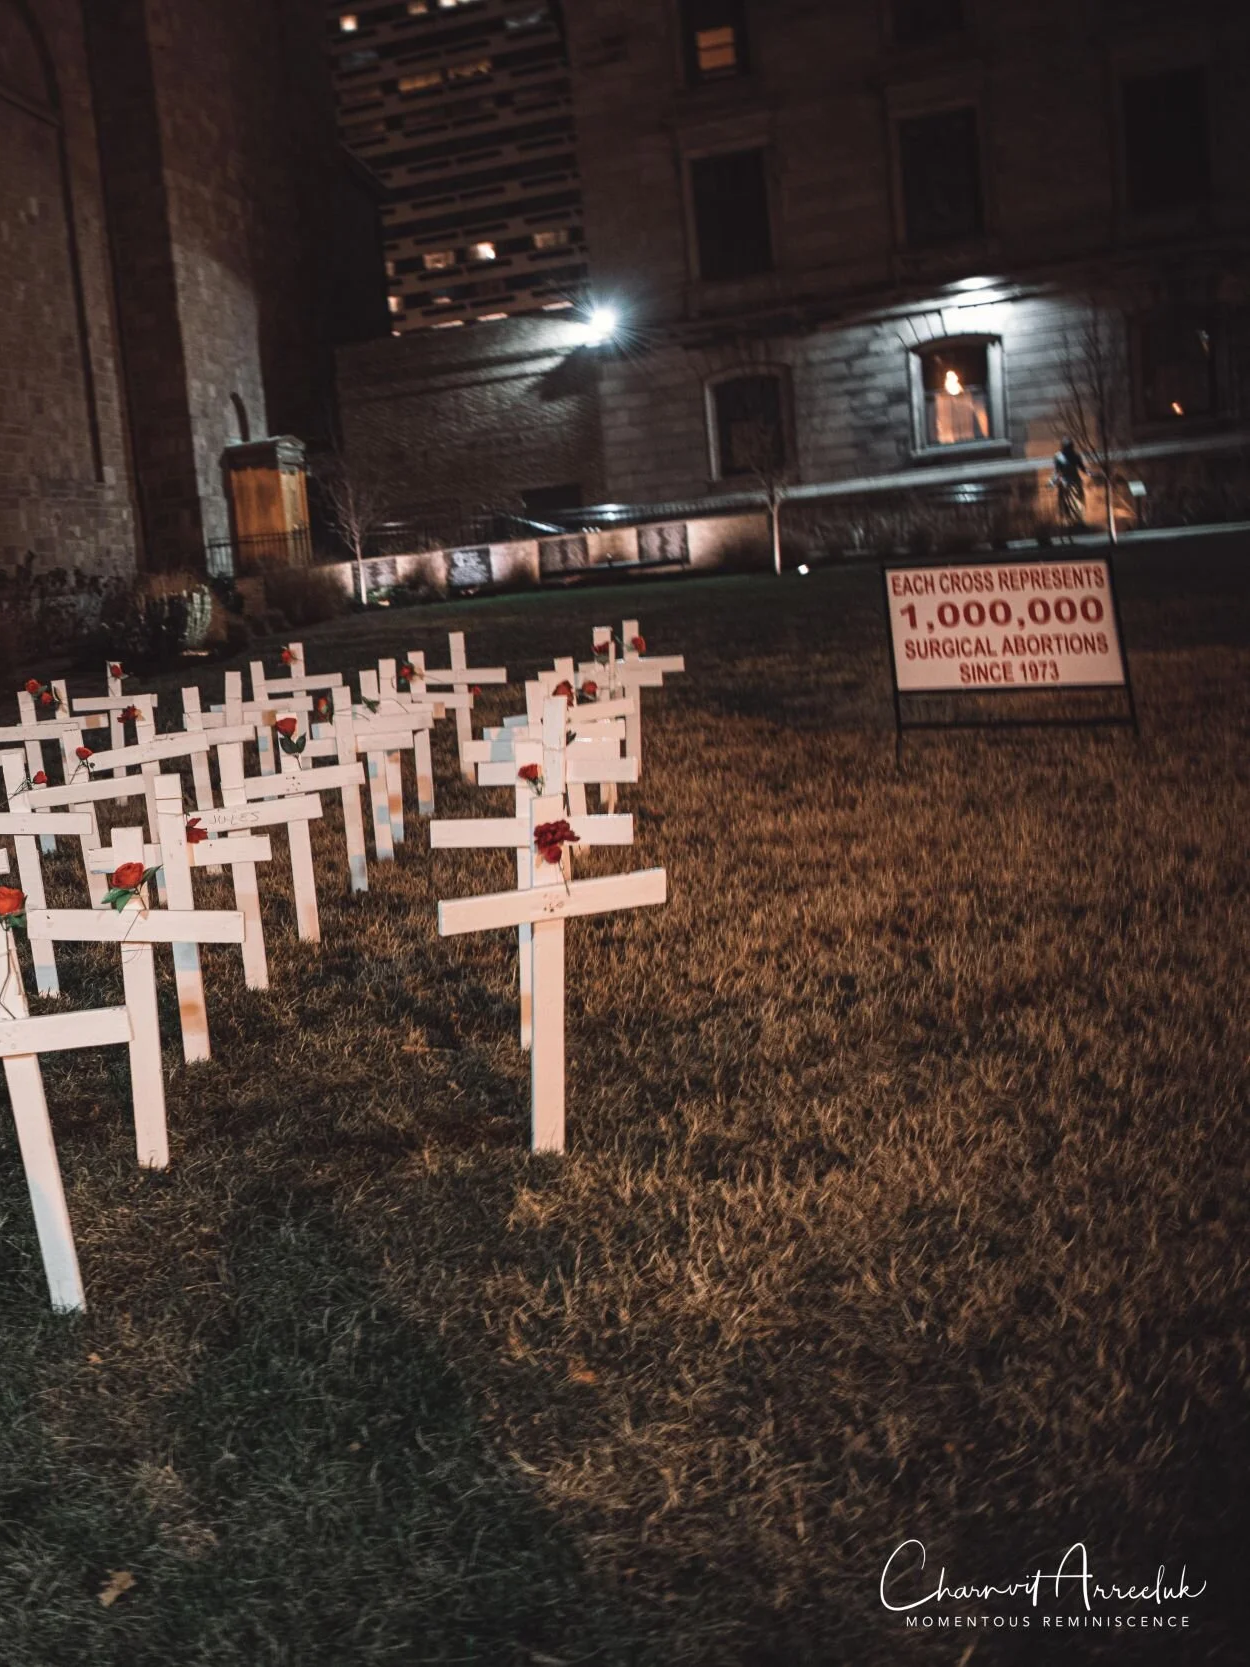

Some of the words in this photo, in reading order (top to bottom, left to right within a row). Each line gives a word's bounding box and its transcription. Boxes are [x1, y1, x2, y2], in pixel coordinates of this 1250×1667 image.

[891, 572, 936, 597] EACH
[939, 569, 995, 594] CROSS
[998, 565, 1105, 592] REPRESENTS
[900, 595, 1104, 634] 1,000,000
[905, 636, 998, 660] SURGICAL
[1001, 632, 1109, 657] ABORTIONS
[959, 660, 1015, 684] SINCE
[1019, 659, 1060, 682] 1973
